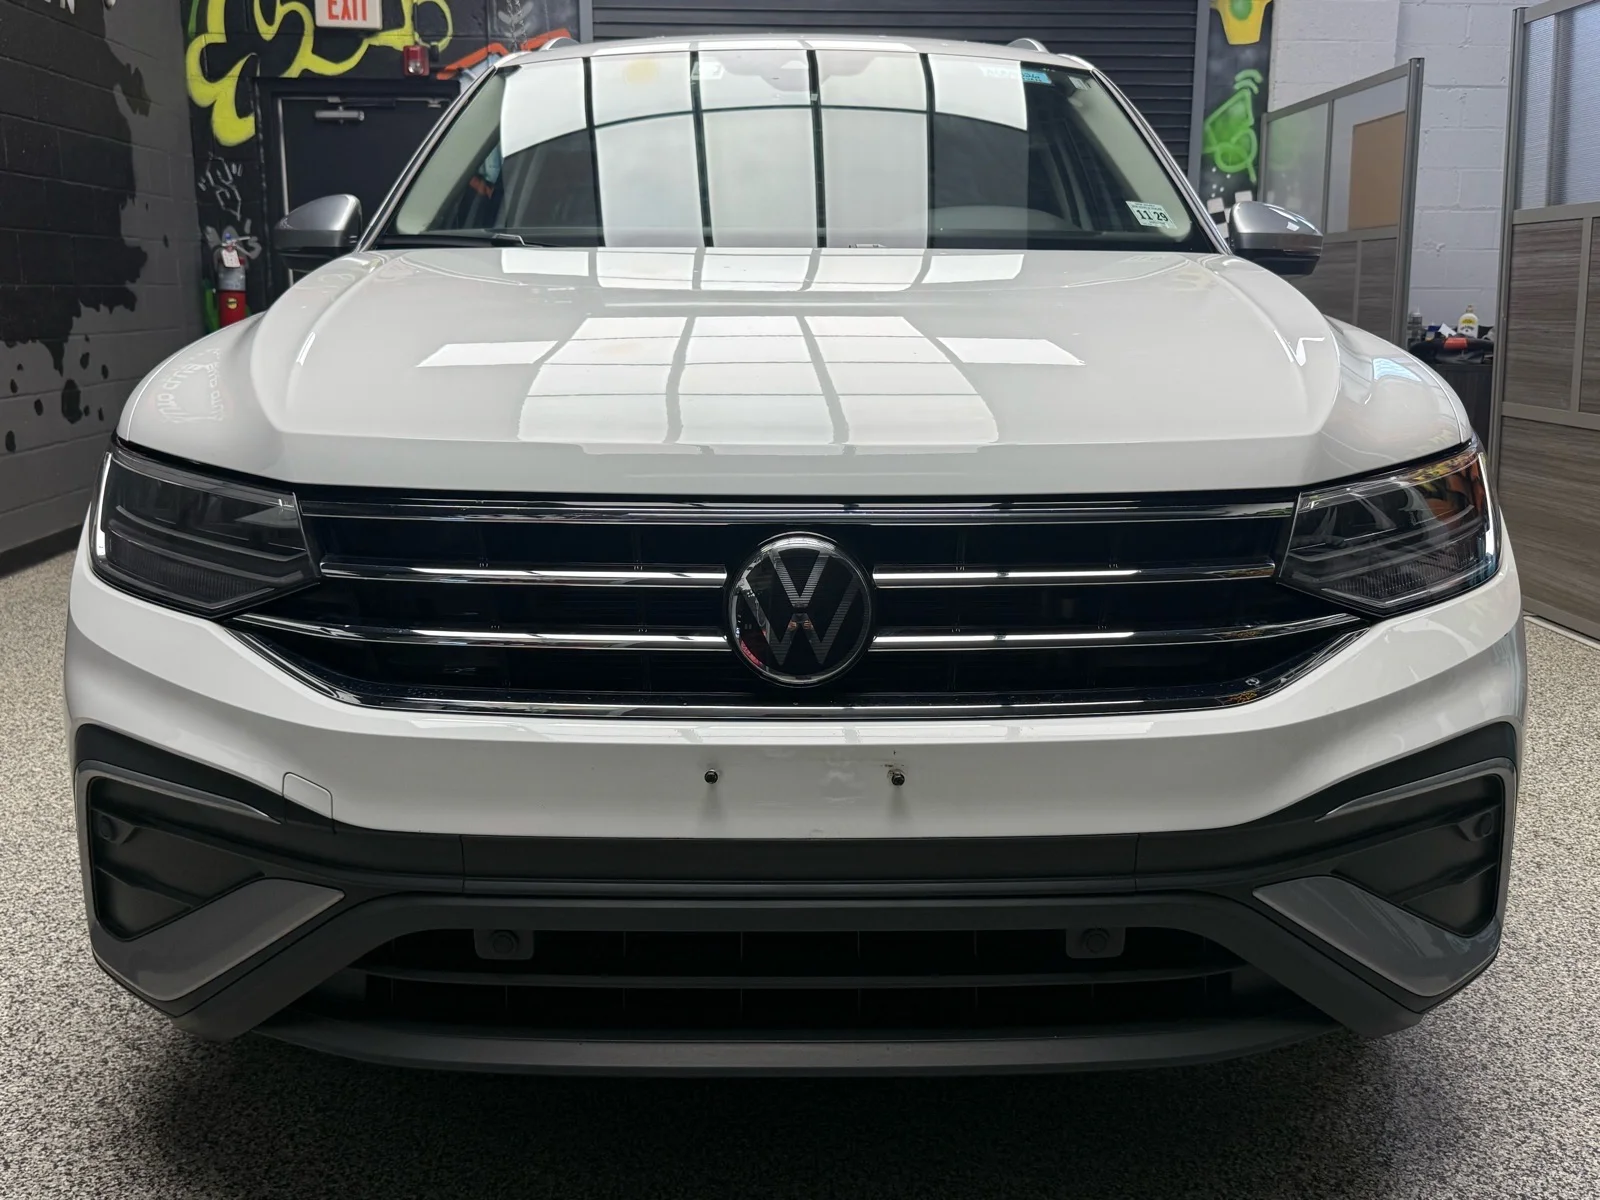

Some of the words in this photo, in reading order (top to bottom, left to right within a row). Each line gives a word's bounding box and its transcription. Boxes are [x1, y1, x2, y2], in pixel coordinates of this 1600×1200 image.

[328, 0, 367, 20] EXIT
[1136, 209, 1153, 220] 11
[1153, 211, 1169, 221] 29
